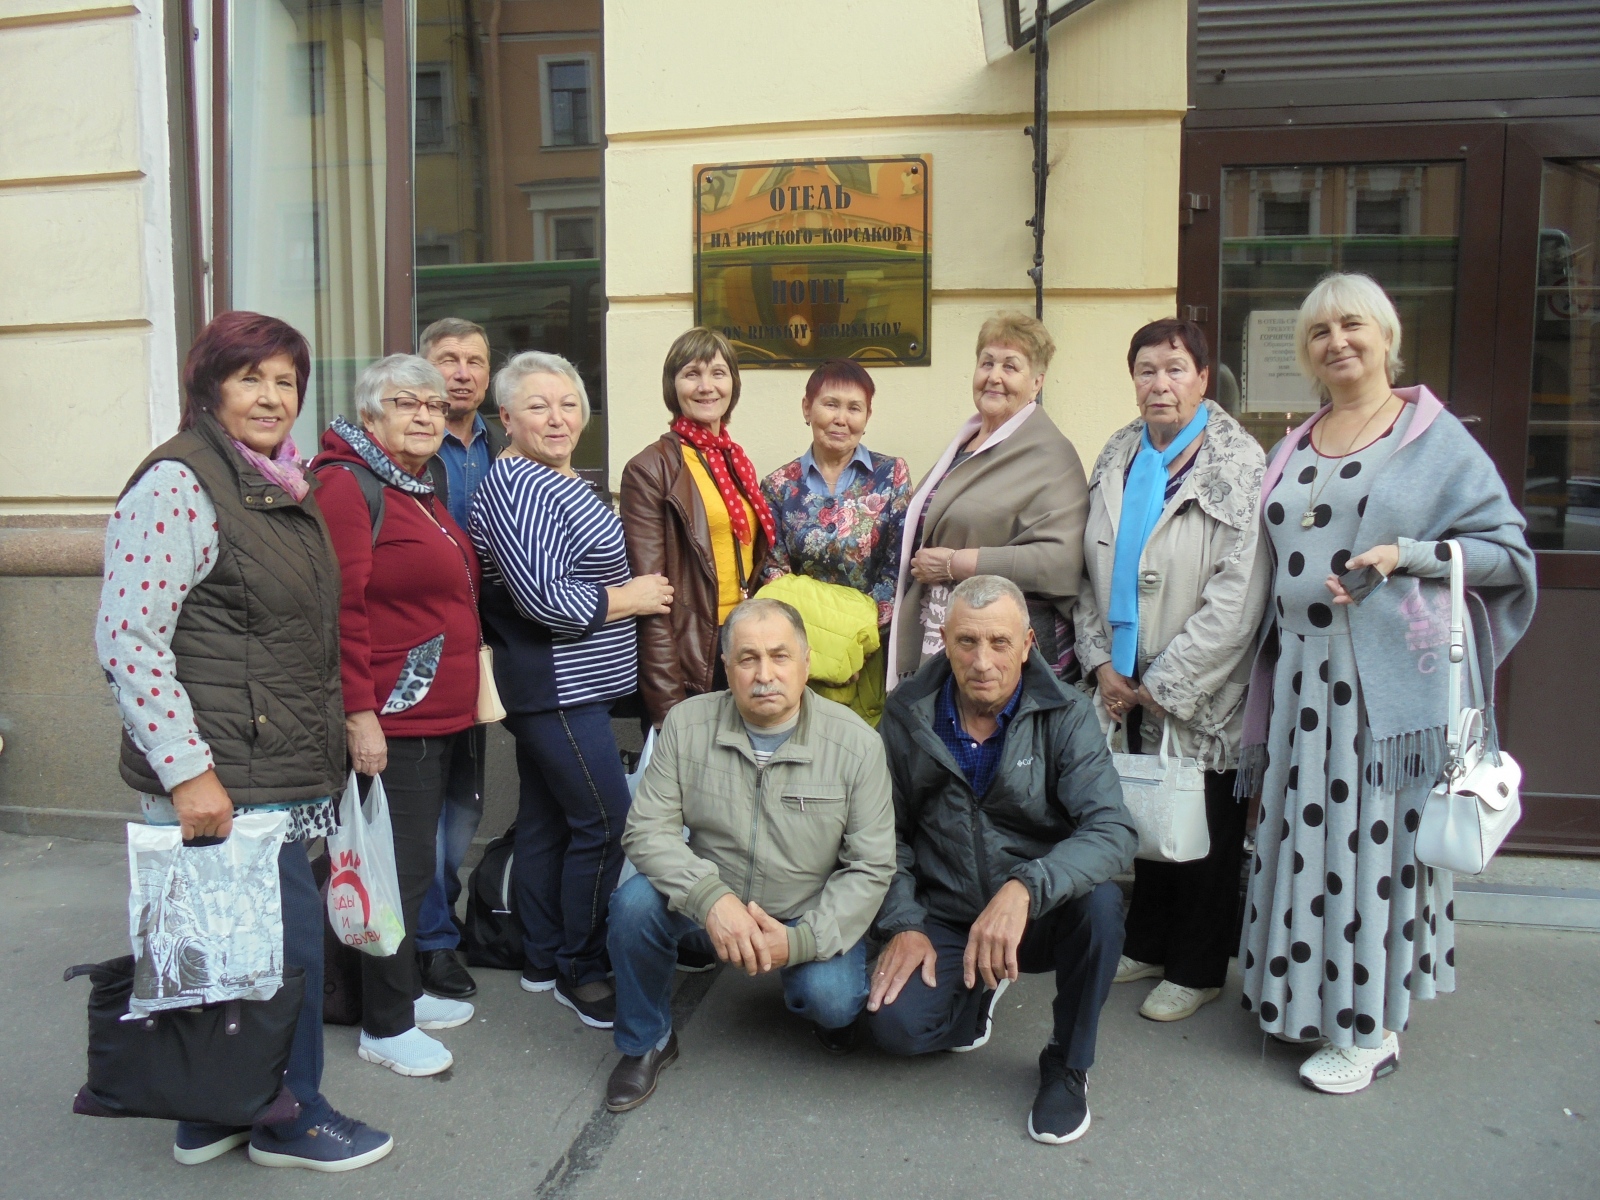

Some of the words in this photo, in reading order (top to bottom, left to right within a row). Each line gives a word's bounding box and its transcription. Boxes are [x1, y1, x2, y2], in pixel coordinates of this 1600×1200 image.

[770, 184, 851, 212] ОТЕЛЬ
[710, 232, 731, 248] НА
[736, 226, 913, 247] РИМСКОГО-КОРСАКОВА
[771, 278, 849, 305] HOTEL
[722, 325, 742, 340] ON
